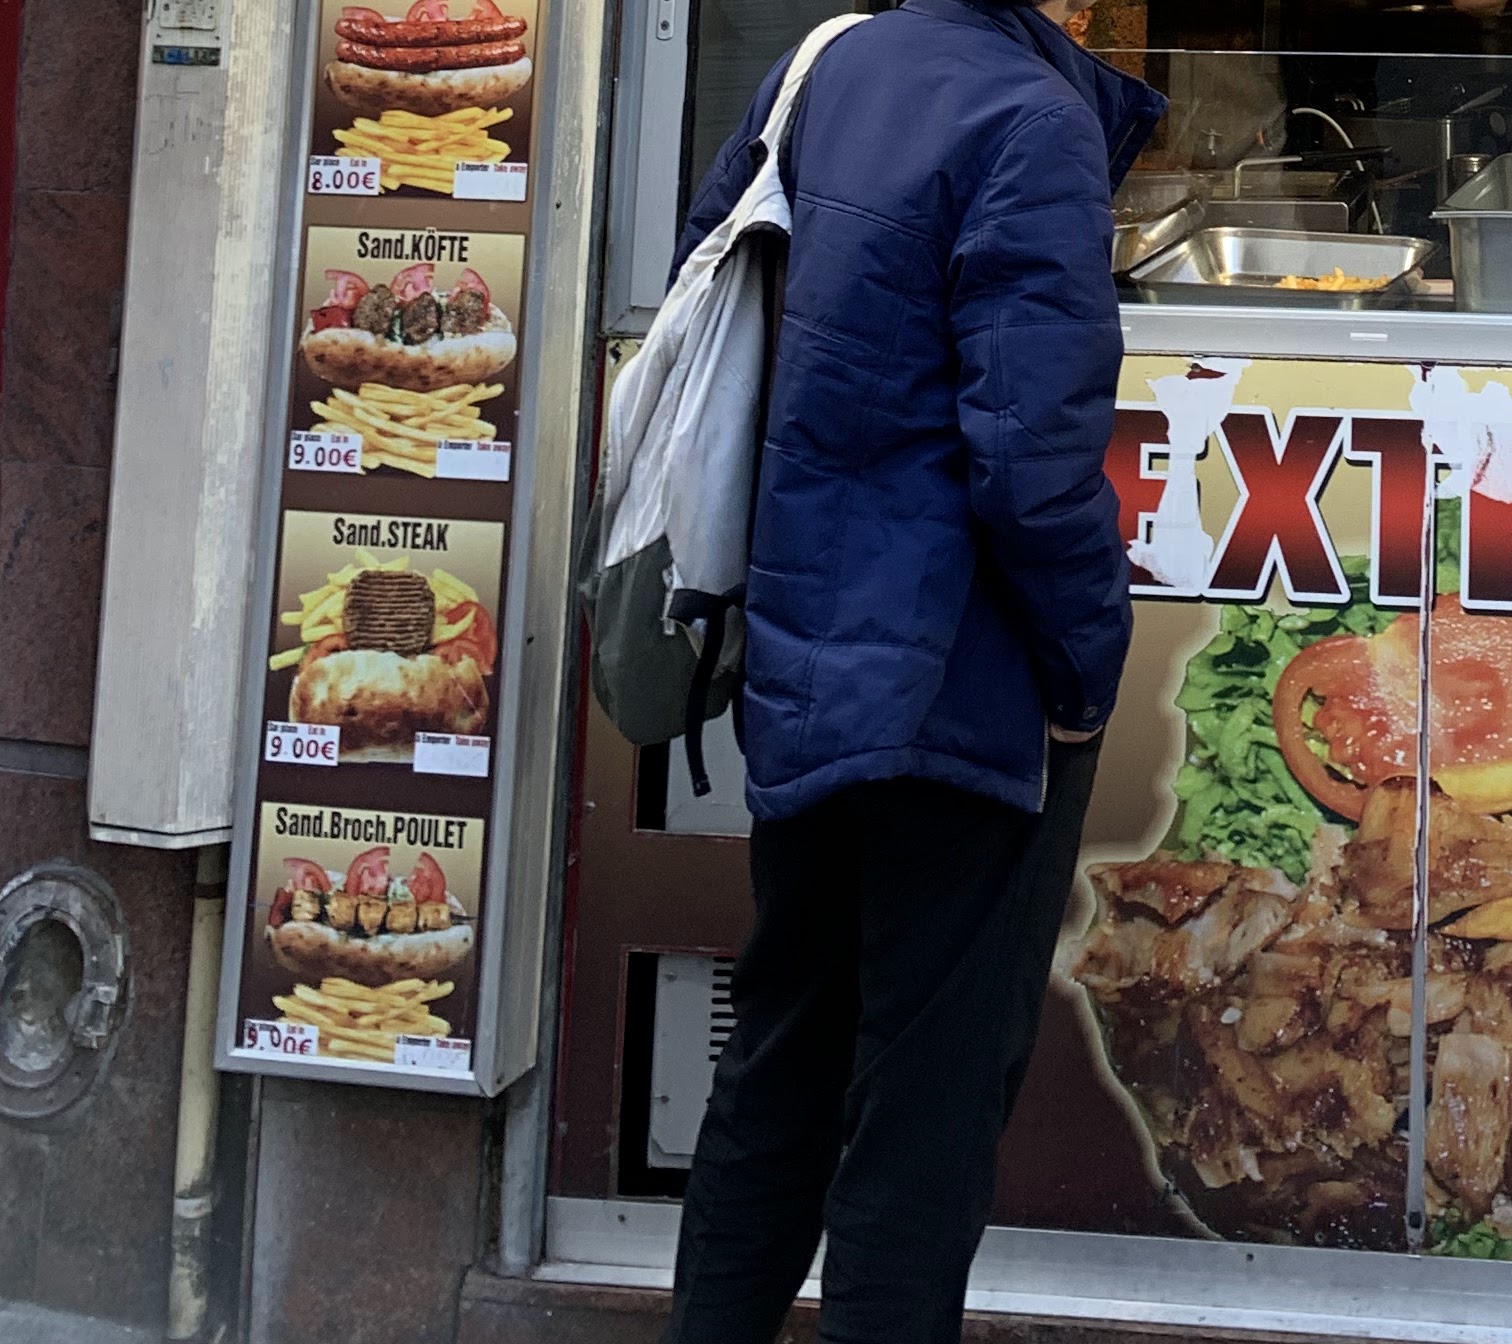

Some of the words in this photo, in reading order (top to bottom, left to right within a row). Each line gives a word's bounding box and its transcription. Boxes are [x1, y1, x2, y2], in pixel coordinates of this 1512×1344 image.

[311, 170, 376, 191] 8.00€
[357, 228, 470, 263] Sand.KÖFTE
[293, 443, 358, 468] 9.00€
[332, 517, 449, 551] Sand.STEAK
[275, 806, 468, 849] Sand.Broch.POULET
